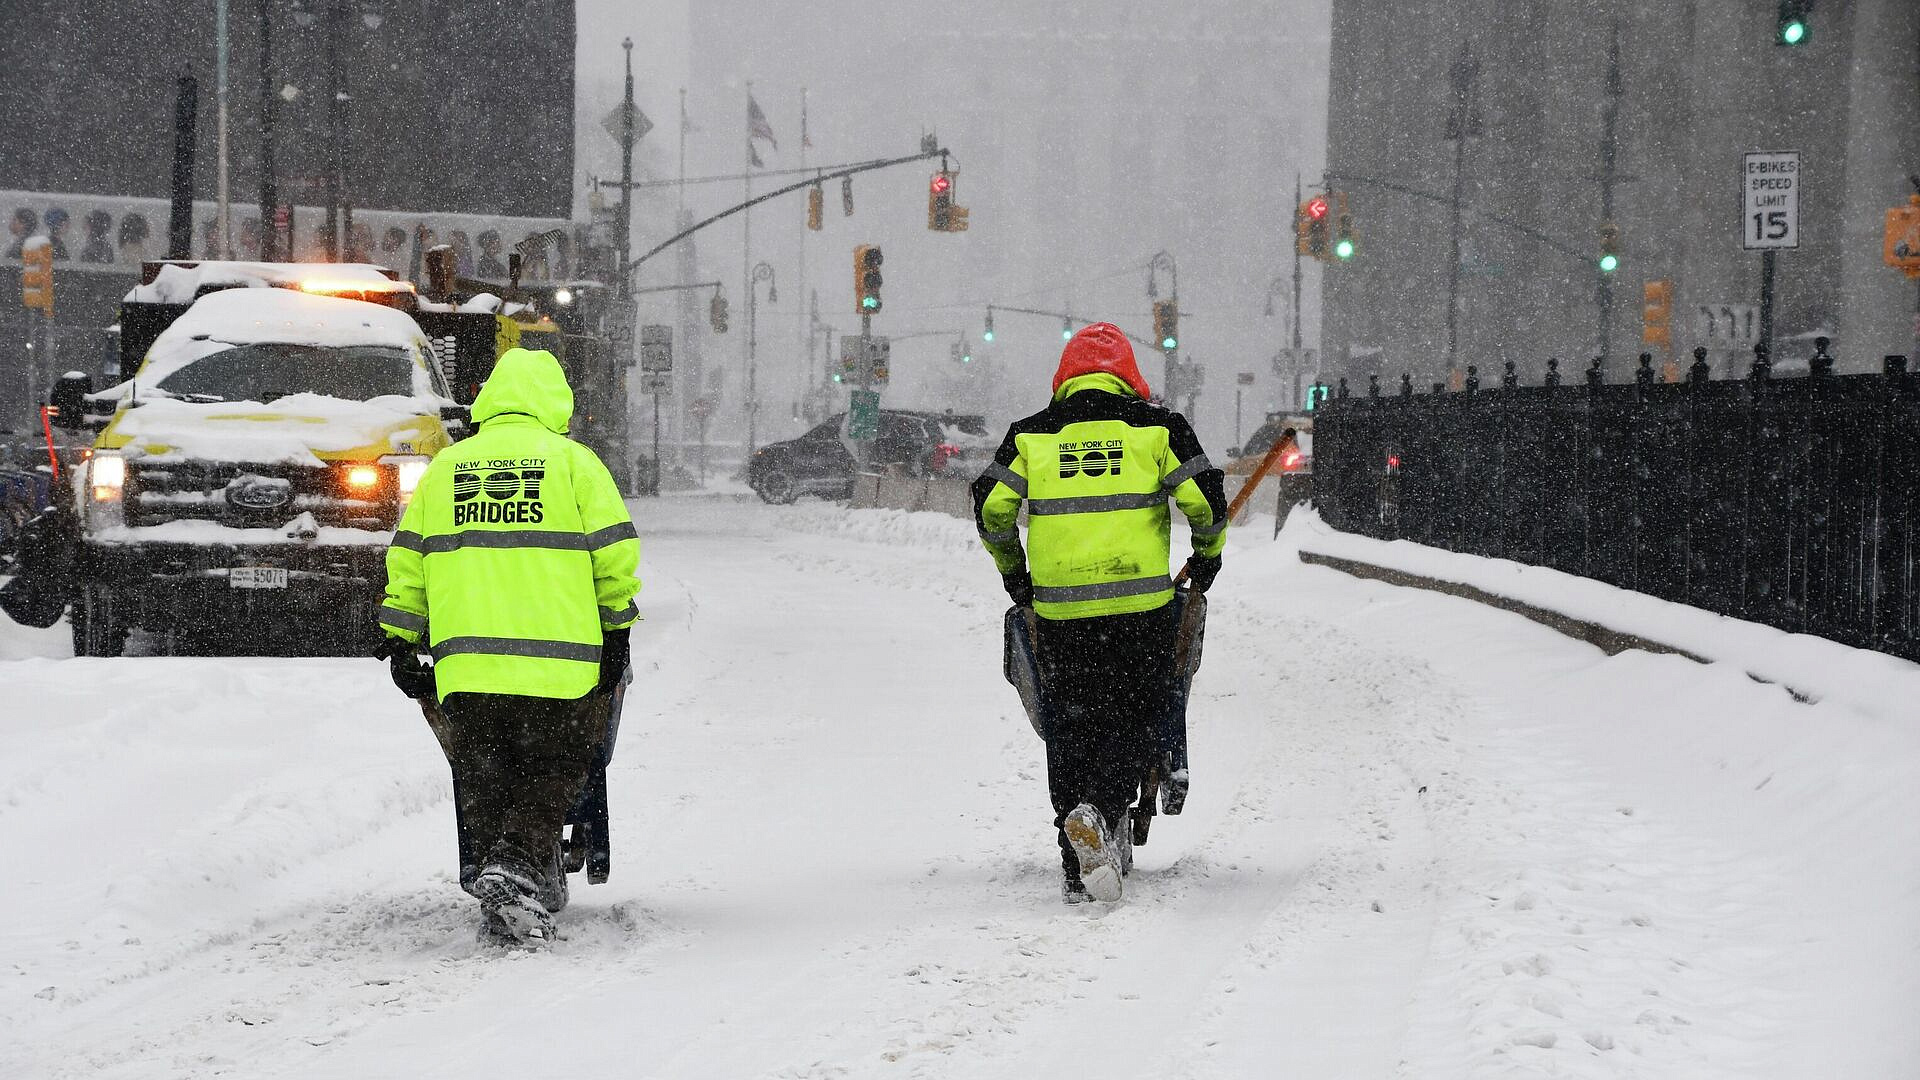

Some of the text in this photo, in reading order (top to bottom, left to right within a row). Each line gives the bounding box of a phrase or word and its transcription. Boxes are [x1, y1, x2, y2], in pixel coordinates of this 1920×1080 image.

[1748, 161, 1796, 174] E-BIKES
[1752, 178, 1792, 190] SPEED
[1755, 195, 1787, 207] LIMIT
[1753, 211, 1789, 240] 15
[1081, 441, 1103, 449] YORK
[455, 458, 546, 470] NEW YORK CITY
[1059, 450, 1123, 479] DOT
[454, 470, 545, 502] DOT
[454, 501, 544, 527] BRIDGES
